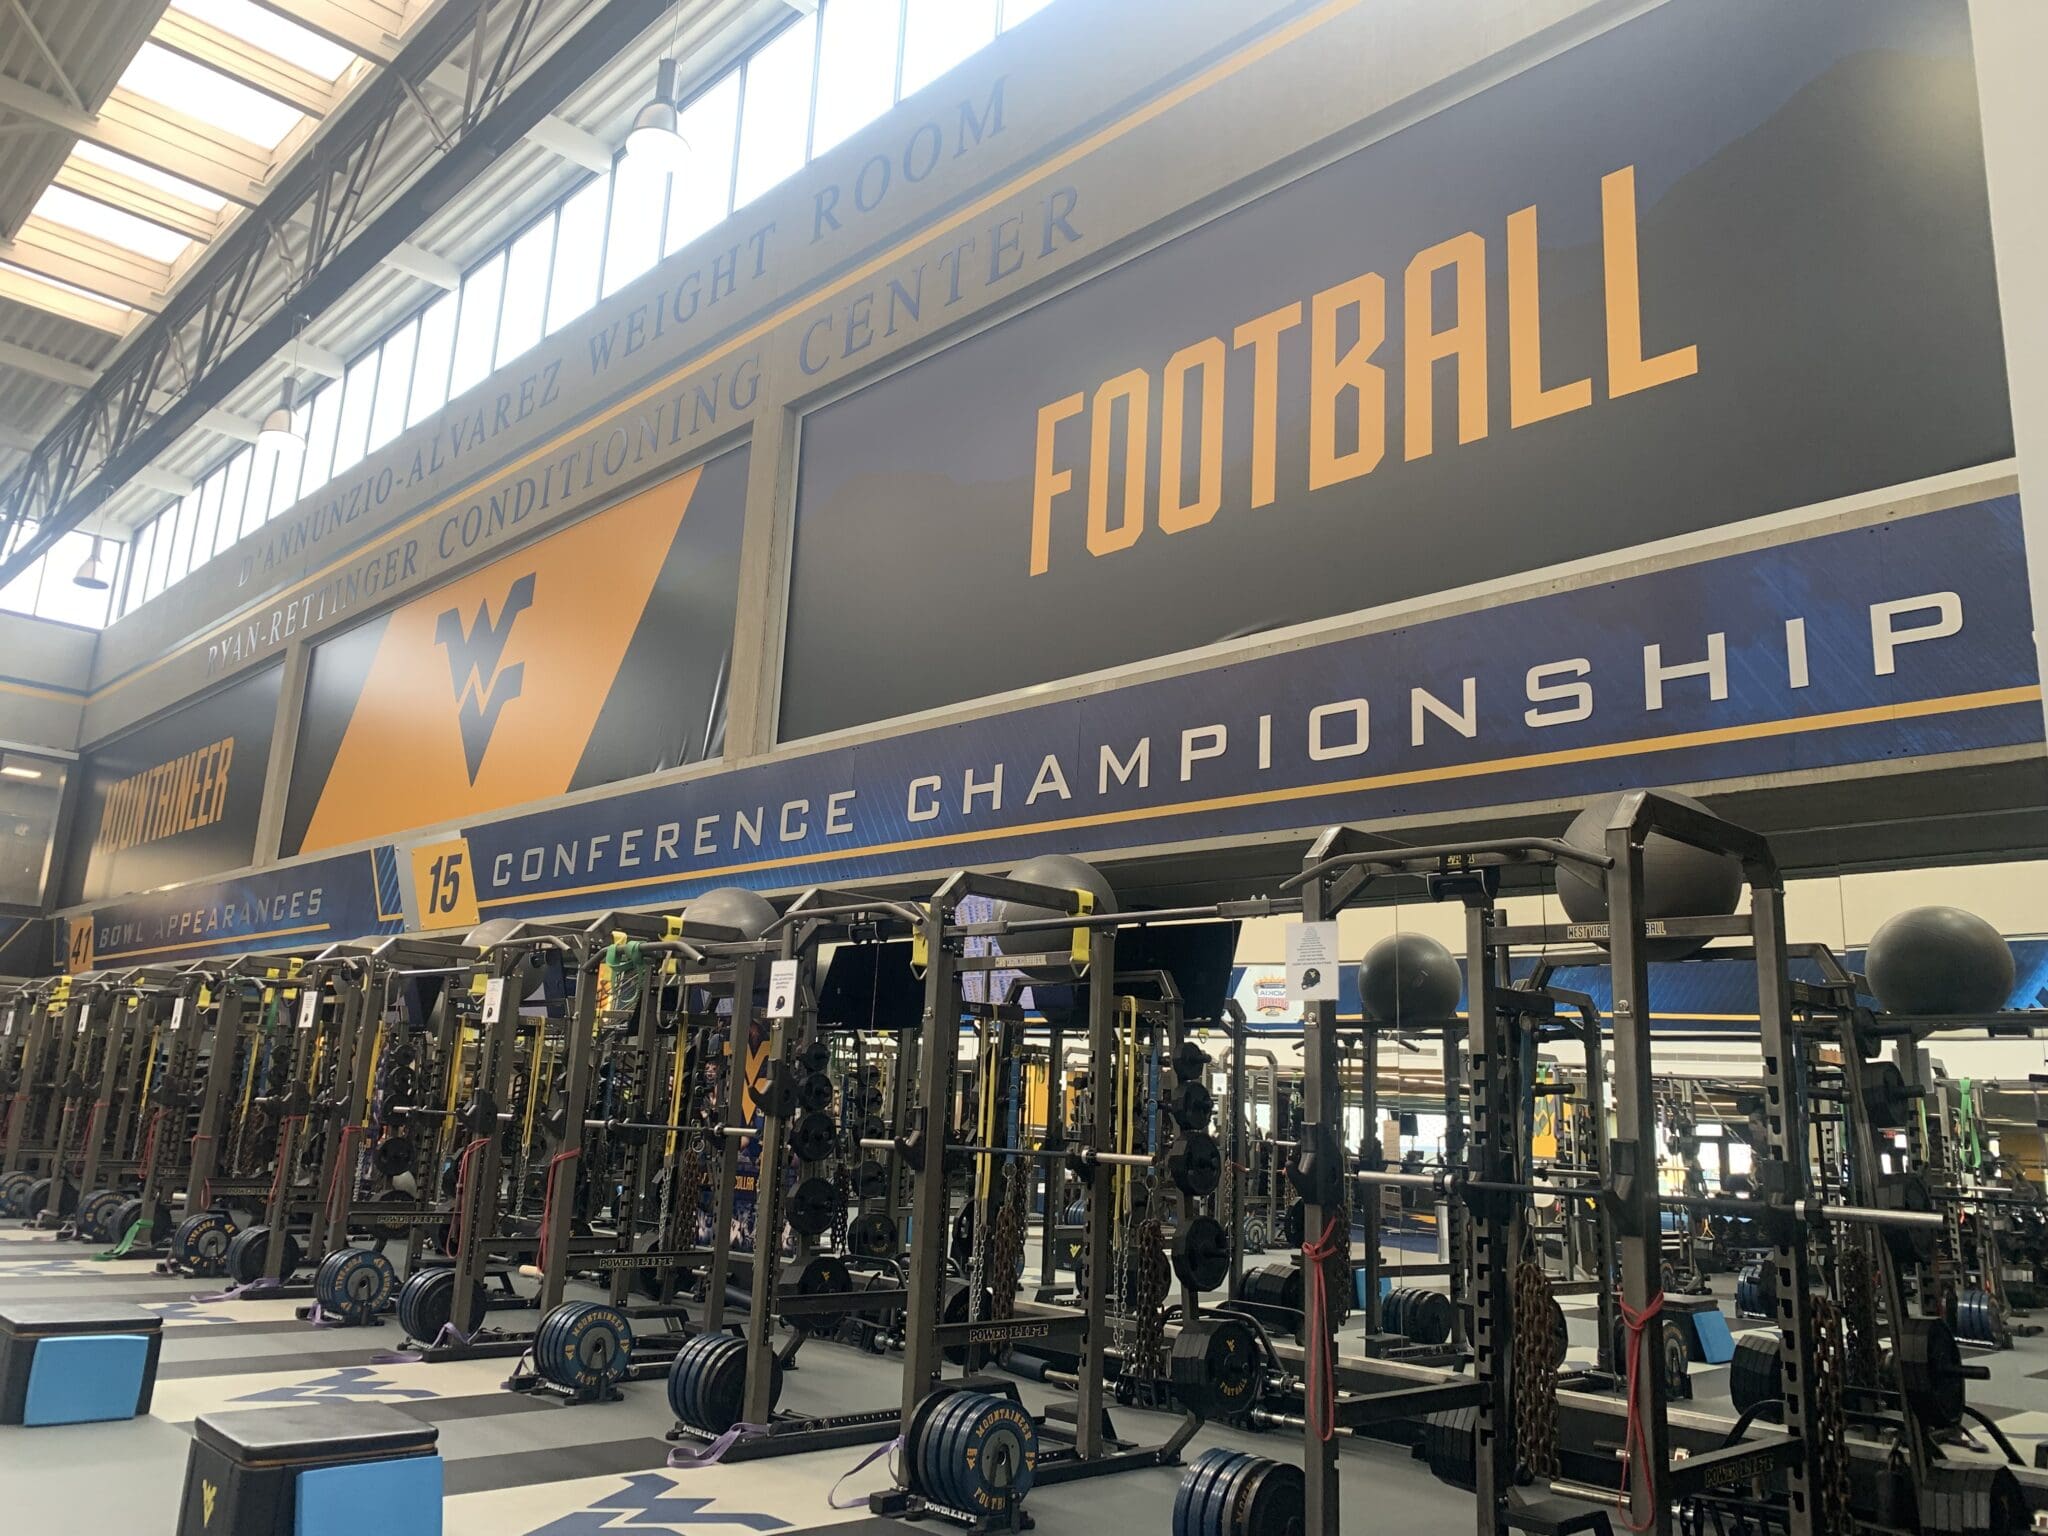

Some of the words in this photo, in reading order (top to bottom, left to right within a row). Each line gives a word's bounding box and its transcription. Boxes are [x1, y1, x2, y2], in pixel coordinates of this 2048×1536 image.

[236, 357, 563, 588] D'ANNUNZIO-ALVAREZ
[588, 222, 776, 377] WEIGHT
[810, 74, 1010, 244] ROOM
[1030, 164, 1698, 577] FOOTBALL
[206, 539, 418, 678] RYAN-RETTINGER
[438, 352, 763, 561] CONDITIONING
[799, 184, 1083, 377] CENTER
[428, 854, 463, 915] 15
[492, 790, 857, 888] CONFERENCE
[906, 591, 1963, 824] CHAMPIONSHIP
[95, 736, 234, 856] MOUNTAINEER
[71, 926, 92, 965] 41
[99, 922, 144, 949] BOWL
[155, 888, 323, 940] APPEARANCES
[1568, 926, 1587, 938] WEST
[1589, 925, 1610, 937] VIRGI
[1645, 921, 1665, 934] BALL
[600, 1258, 634, 1268] POWER
[637, 1256, 674, 1266] LIFT
[571, 1311, 625, 1337] MOUNTAINEER
[969, 1327, 1007, 1342] POWER
[1009, 1324, 1049, 1338] LIFT
[575, 1367, 618, 1386] FOOTLL
[976, 1408, 1032, 1441] MOUNTAINEER
[974, 1487, 1006, 1510] FOOTB
